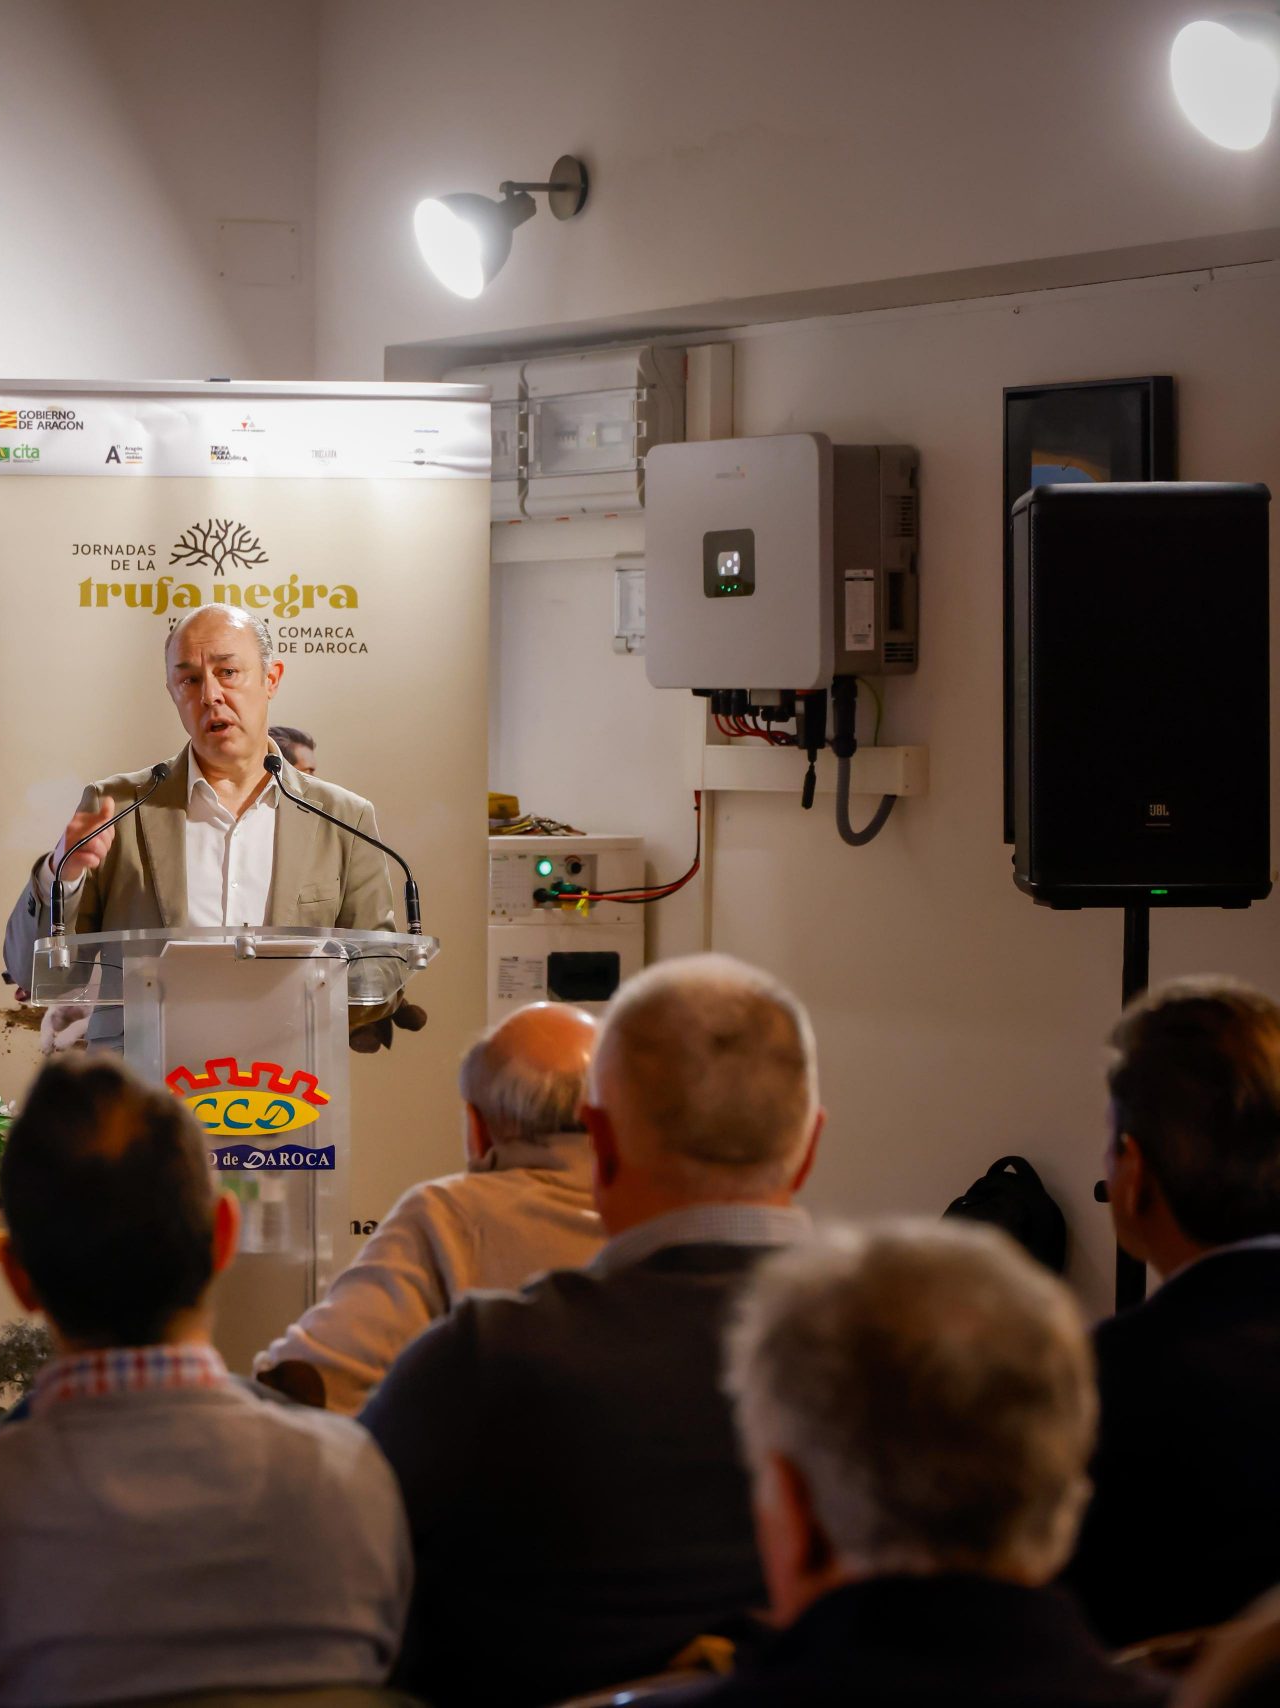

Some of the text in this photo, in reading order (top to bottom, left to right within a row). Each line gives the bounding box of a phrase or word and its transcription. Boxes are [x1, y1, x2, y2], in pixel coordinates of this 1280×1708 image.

[18, 410, 76, 420] GOBIERNO
[18, 421, 84, 430] DE ARAGON
[13, 444, 40, 459] cita
[72, 544, 157, 556] JORNADAS
[111, 559, 156, 571] DE LA
[77, 573, 359, 619] trufa negra
[278, 626, 355, 639] COMARCA
[278, 642, 369, 653] DE DAROCA
[1150, 804, 1169, 816] JBL
[222, 1152, 239, 1166] de
[242, 1151, 330, 1169] DAROCA
